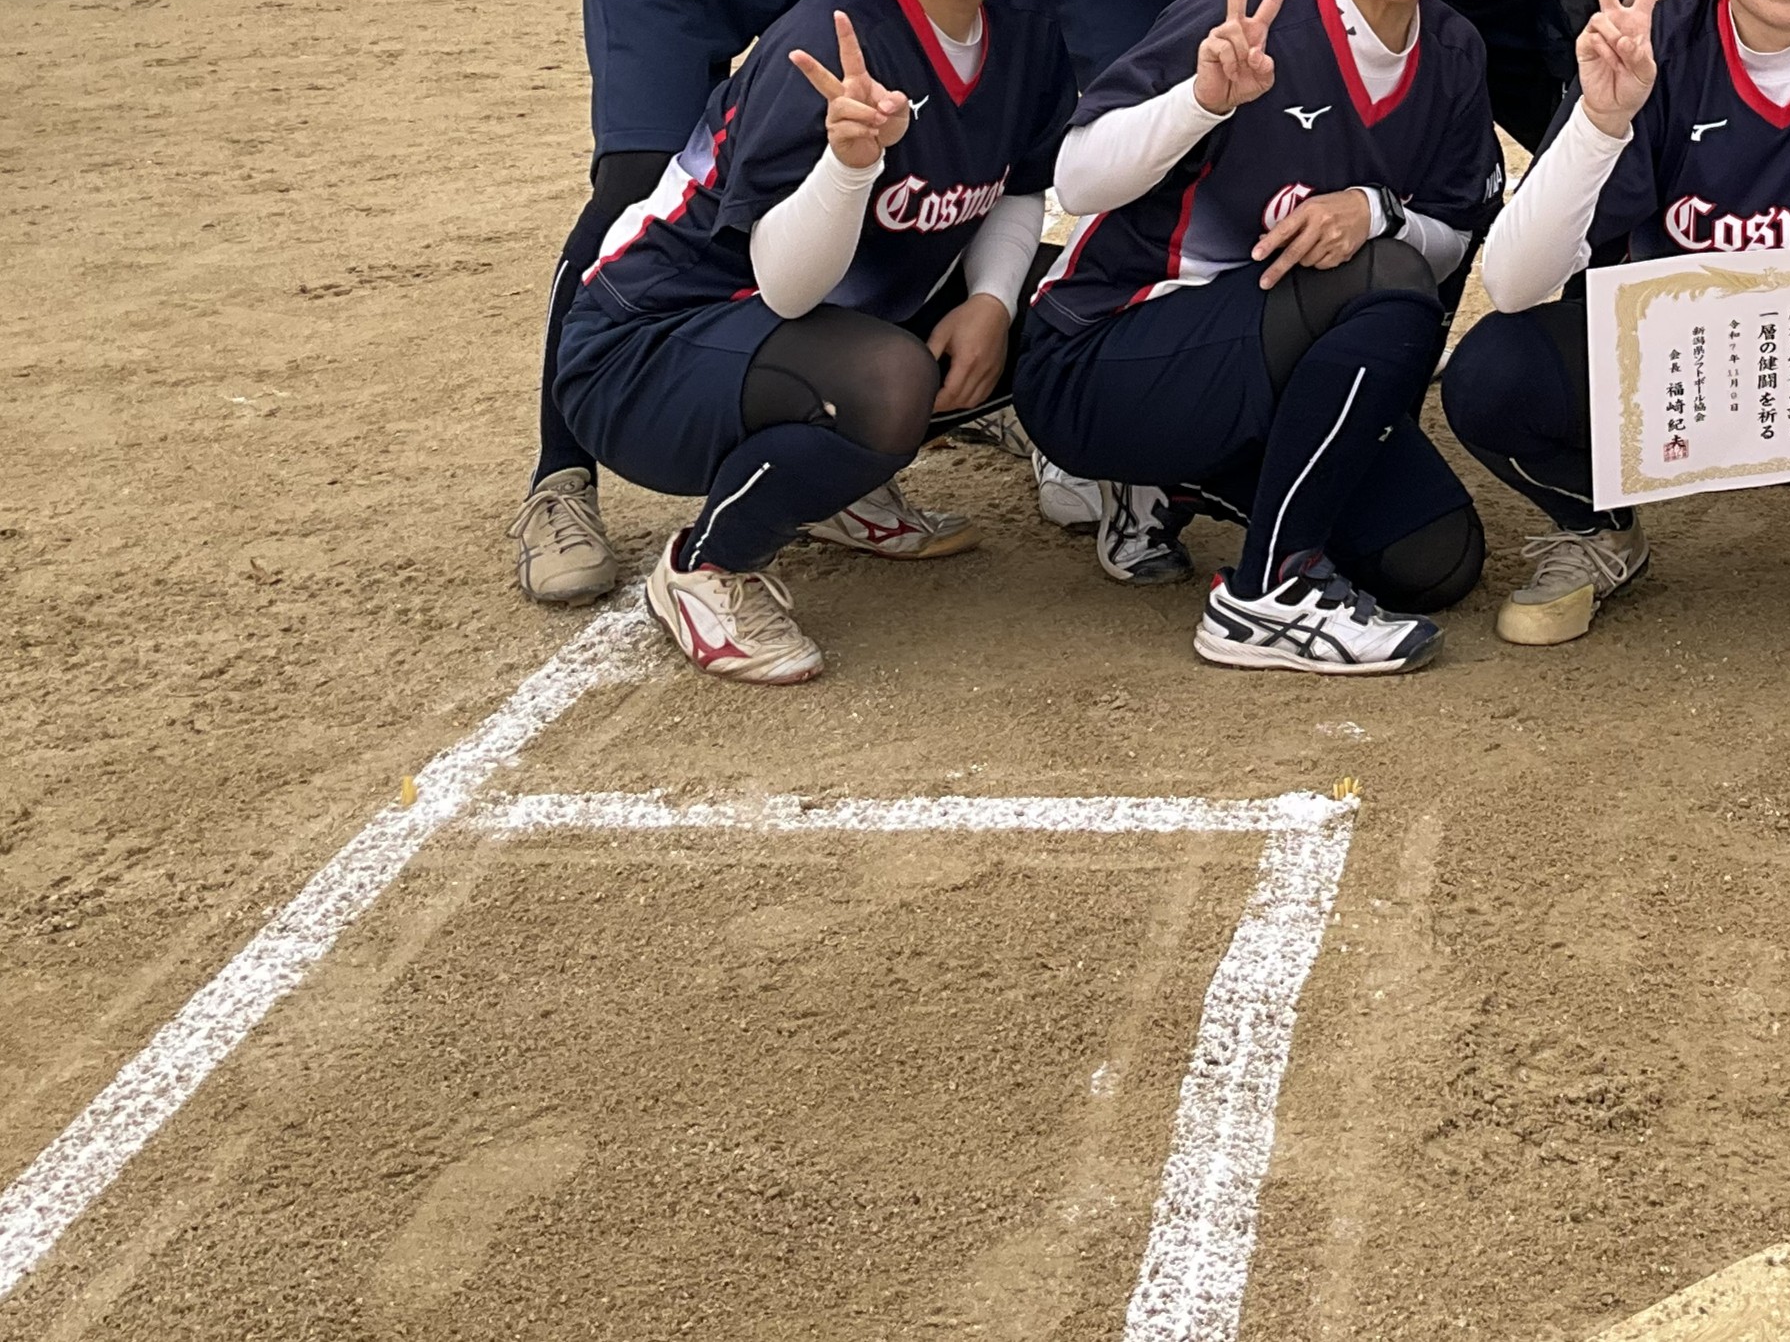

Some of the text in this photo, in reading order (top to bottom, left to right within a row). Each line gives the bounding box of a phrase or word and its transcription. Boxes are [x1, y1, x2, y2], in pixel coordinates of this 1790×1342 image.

[1692, 325, 1707, 422] 新潟県ソフトボール協会
[1757, 311, 1779, 440] 一層の健闘を祈る
